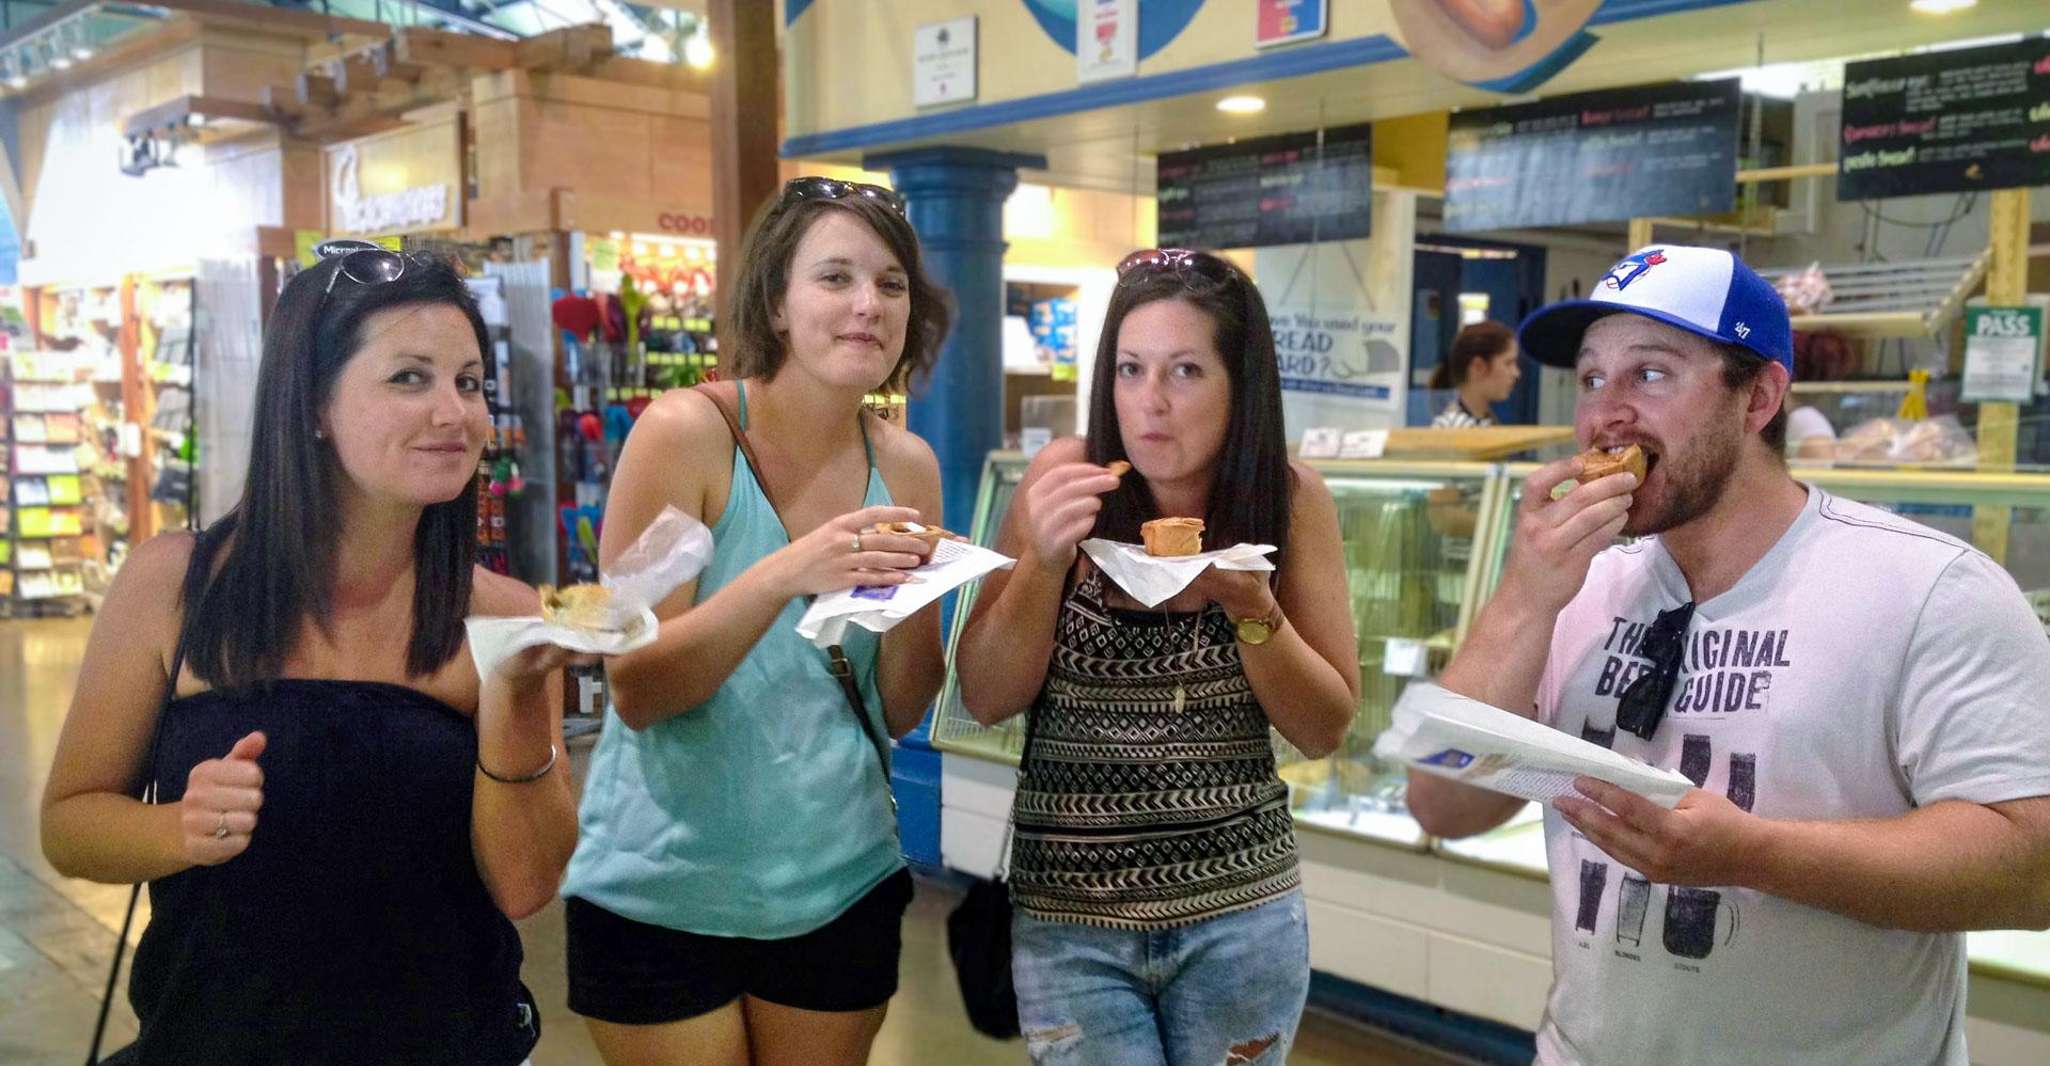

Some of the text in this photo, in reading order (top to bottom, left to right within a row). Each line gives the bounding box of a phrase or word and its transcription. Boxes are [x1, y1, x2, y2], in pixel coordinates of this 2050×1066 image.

[658, 212, 718, 235] COO
[1324, 317, 1360, 332] used
[1362, 321, 1397, 336] your
[1977, 314, 2031, 336] PASS
[1271, 330, 1333, 353] READ
[1276, 354, 1316, 376] ARD
[1681, 629, 1791, 673] IGINAL
[1674, 670, 1772, 714] GUIDE
